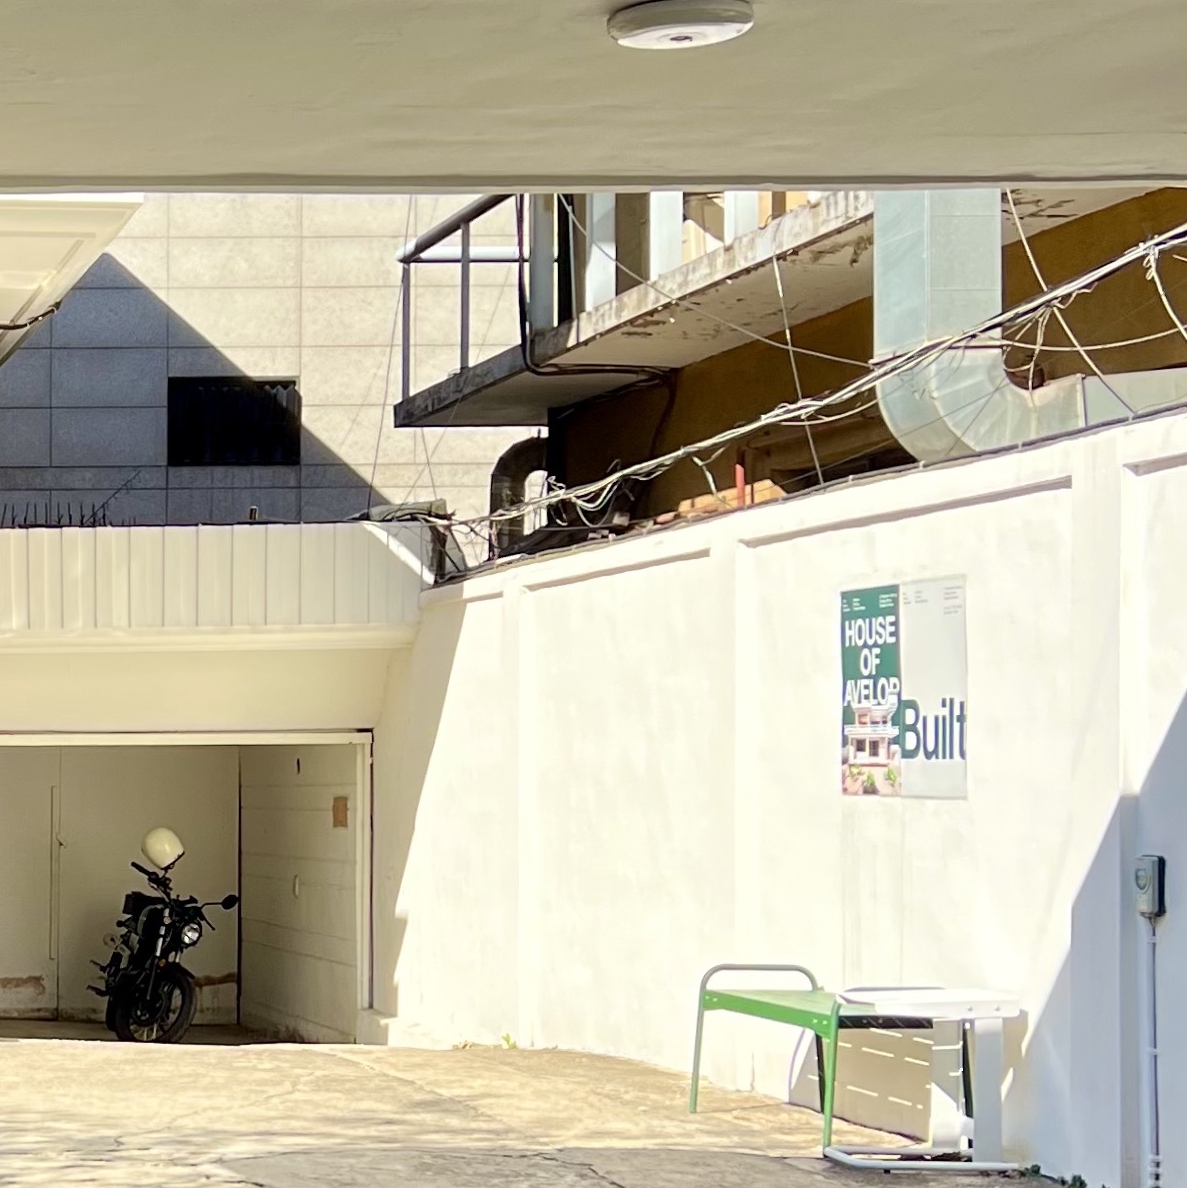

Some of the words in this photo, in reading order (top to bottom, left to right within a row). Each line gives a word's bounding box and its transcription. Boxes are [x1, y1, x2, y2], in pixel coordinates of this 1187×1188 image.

[845, 615, 896, 647] HOUSE
[860, 647, 881, 676] OF
[843, 677, 900, 707] AVELOP
[901, 697, 966, 760] Built
